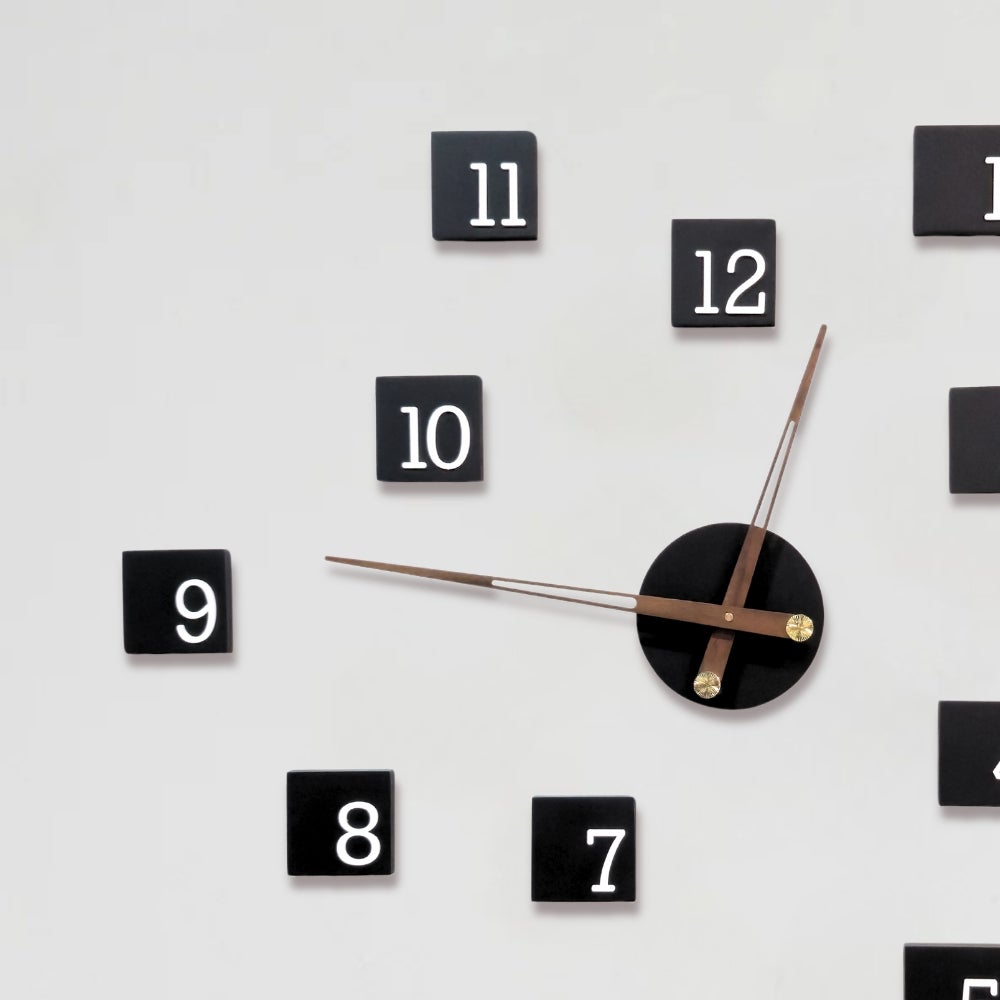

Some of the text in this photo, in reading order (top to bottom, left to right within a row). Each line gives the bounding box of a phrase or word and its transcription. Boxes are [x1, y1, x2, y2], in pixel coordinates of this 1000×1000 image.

[469, 161, 527, 227] 11
[694, 248, 767, 315] 12
[400, 404, 471, 471] 10
[174, 578, 218, 644] 9
[335, 800, 381, 867] 8
[586, 828, 626, 893] 7
